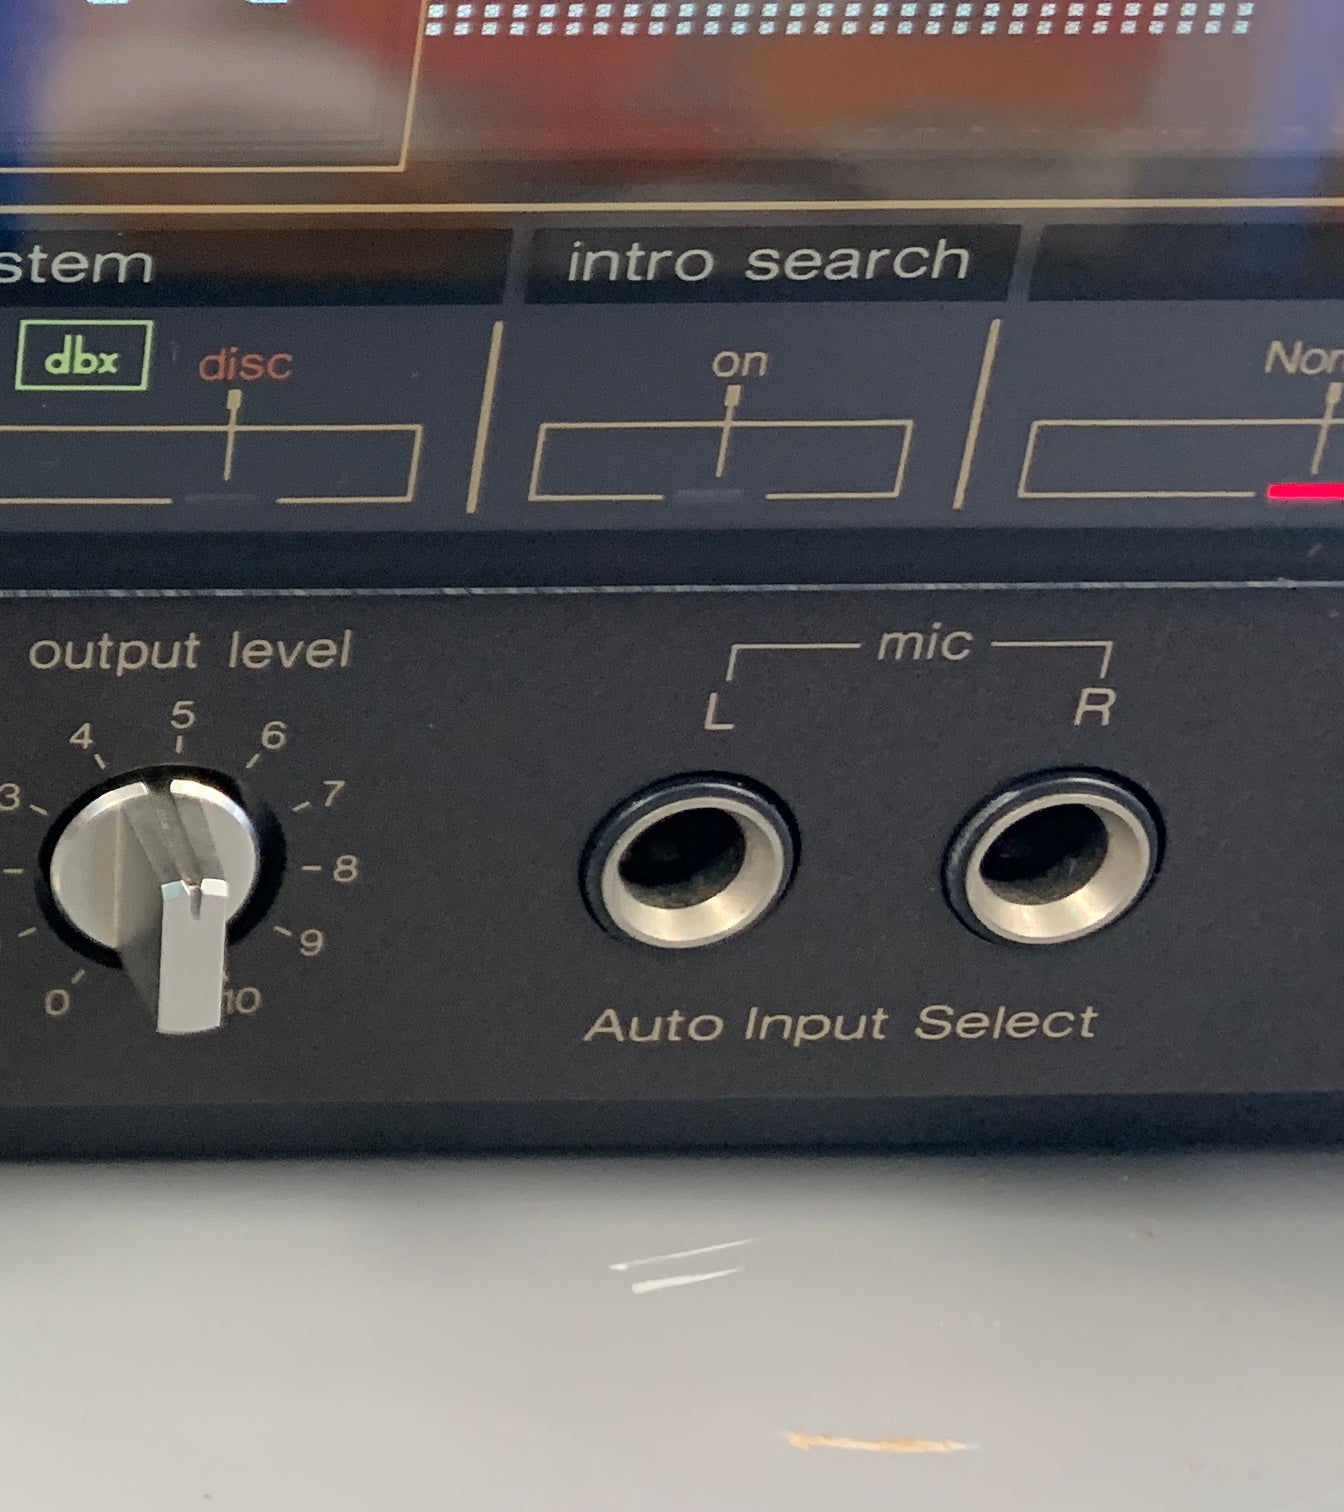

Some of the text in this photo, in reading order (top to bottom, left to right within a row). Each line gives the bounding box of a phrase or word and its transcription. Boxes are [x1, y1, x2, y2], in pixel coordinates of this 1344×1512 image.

[566, 239, 972, 283] intro search
[44, 335, 120, 376] dbx
[198, 347, 293, 382] disc
[712, 348, 768, 378] on
[1264, 339, 1344, 375] Nor
[28, 629, 354, 677] output level
[876, 621, 974, 661] mic
[171, 701, 196, 730] 5
[703, 692, 736, 731] L
[1073, 687, 1117, 727] R
[69, 722, 93, 750] 4
[261, 721, 288, 751] 6
[323, 780, 346, 807] 7
[332, 854, 360, 883] 8
[299, 929, 325, 957] 9
[45, 989, 71, 1016] 0
[583, 1005, 1099, 1048] Auto Input Select
